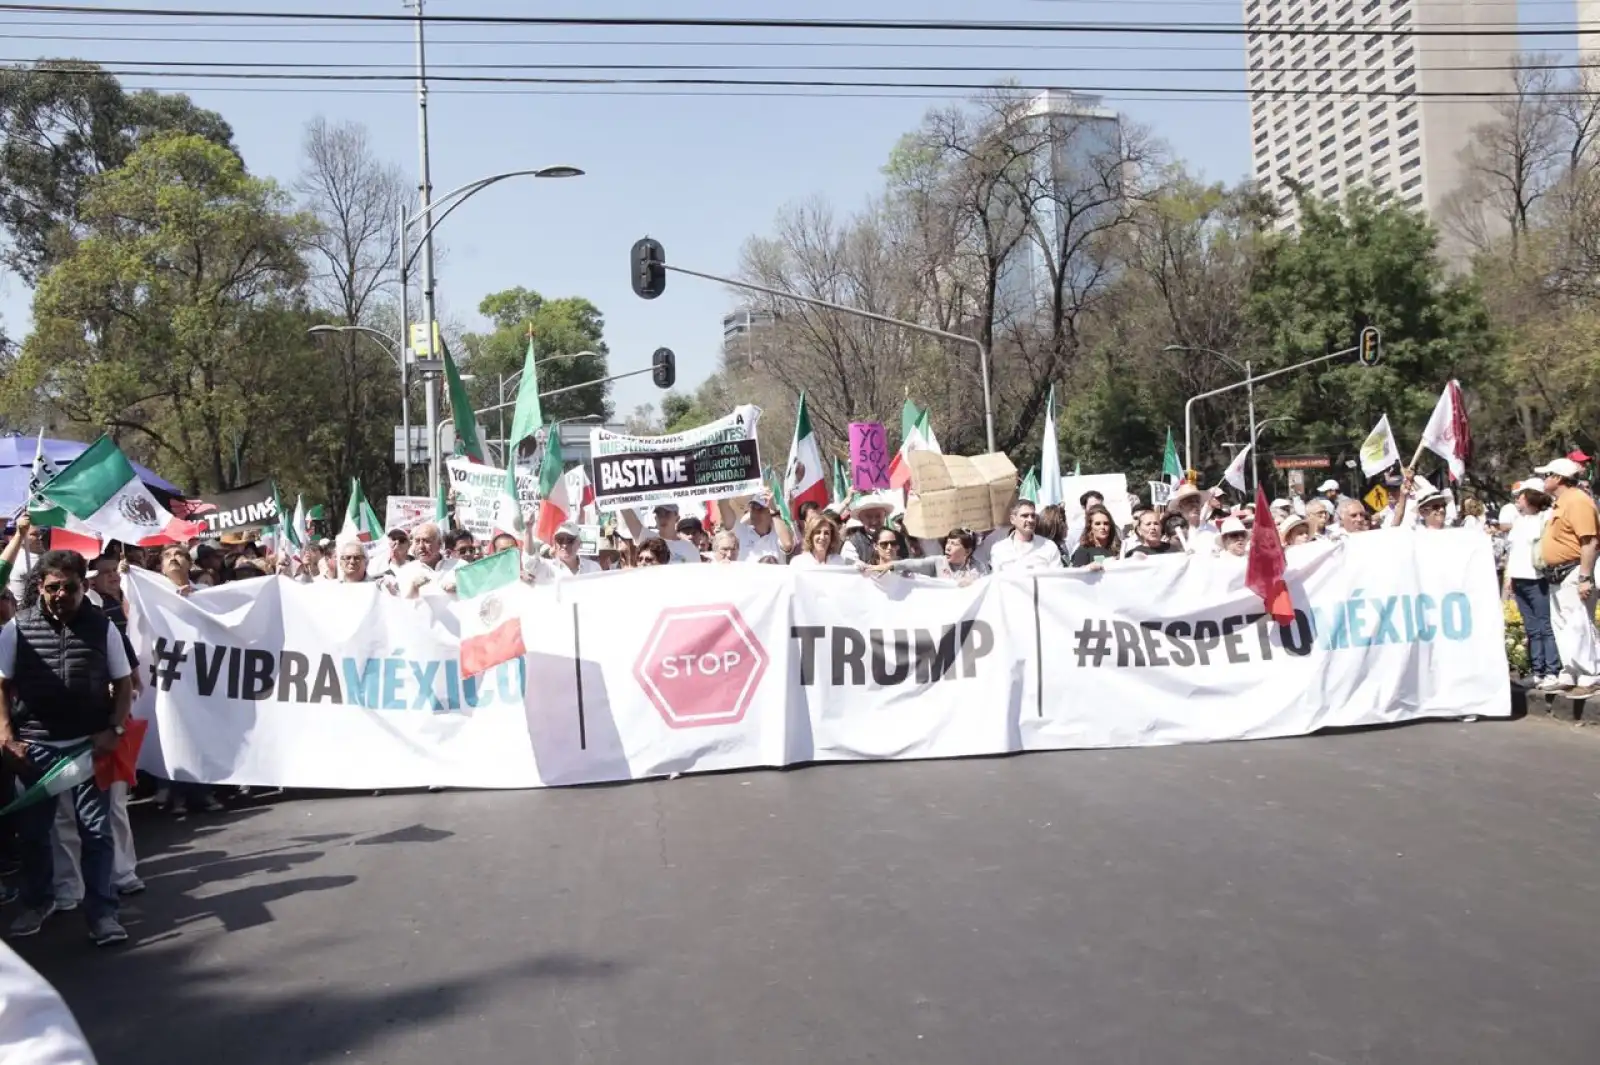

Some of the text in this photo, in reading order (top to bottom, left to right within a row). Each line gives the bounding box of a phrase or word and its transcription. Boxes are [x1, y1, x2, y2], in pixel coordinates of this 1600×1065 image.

[736, 414, 745, 425] A
[451, 466, 467, 482] YO
[601, 458, 659, 491] BASTA
[661, 455, 688, 484] DE
[661, 650, 741, 679] STOP
[791, 620, 995, 686] TRUMP
